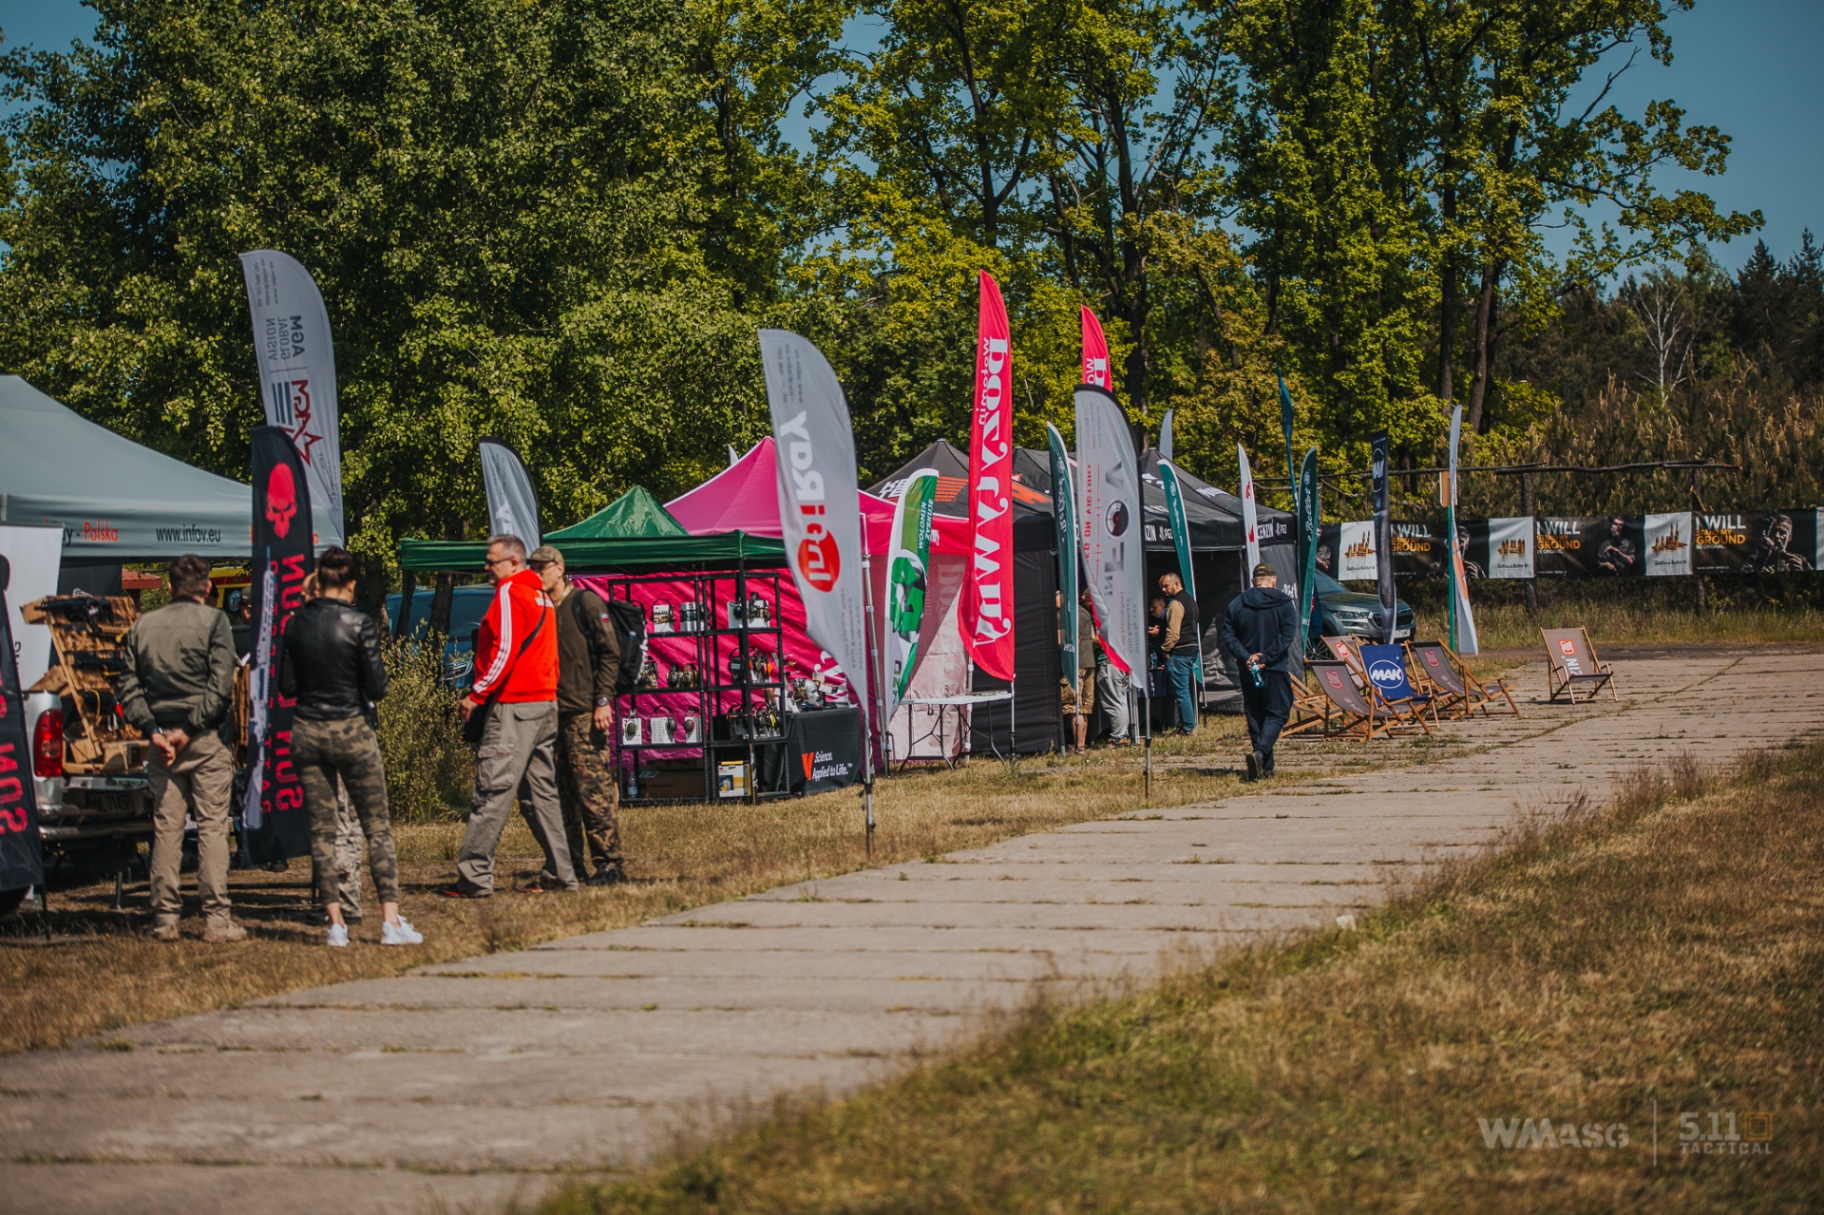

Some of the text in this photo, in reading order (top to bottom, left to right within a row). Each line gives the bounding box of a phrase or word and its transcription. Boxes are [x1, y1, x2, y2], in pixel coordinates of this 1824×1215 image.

[1544, 521, 1581, 534] WILL
[1703, 515, 1747, 529] WILL
[83, 521, 119, 542] Polska
[155, 523, 222, 544] www.infov.eu
[1397, 524, 1432, 537] WILL
[1537, 540, 1581, 549] GROUND
[1696, 534, 1746, 544] GROUND
[1371, 669, 1402, 681] MAK
[812, 765, 829, 782] Applied
[830, 765, 835, 776] to
